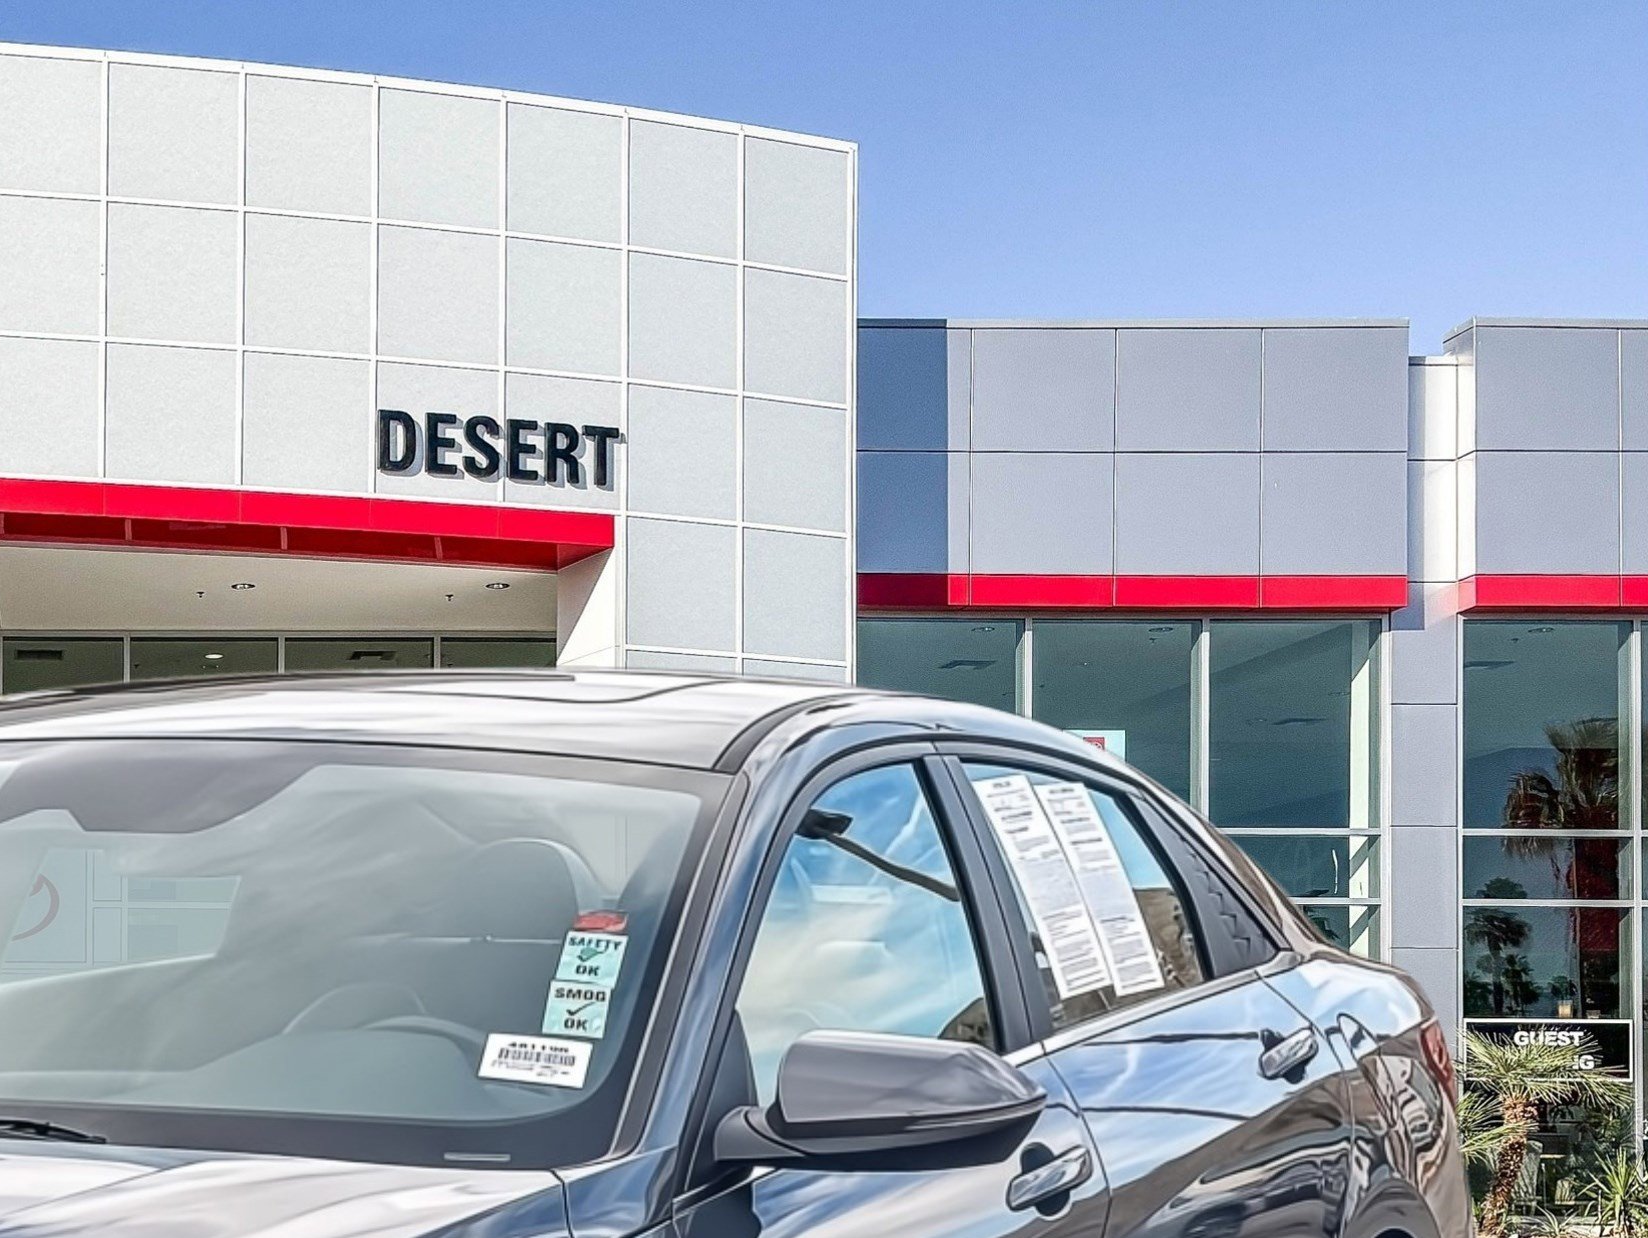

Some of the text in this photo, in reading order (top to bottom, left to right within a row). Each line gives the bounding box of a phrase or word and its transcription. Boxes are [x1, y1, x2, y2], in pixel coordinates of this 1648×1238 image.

[377, 409, 620, 487] DESERT
[568, 937, 622, 951] SAFETY
[575, 964, 600, 976] OK
[554, 987, 606, 1002] SMOG
[563, 1018, 589, 1031] OK
[1513, 1030, 1585, 1047] GUEST
